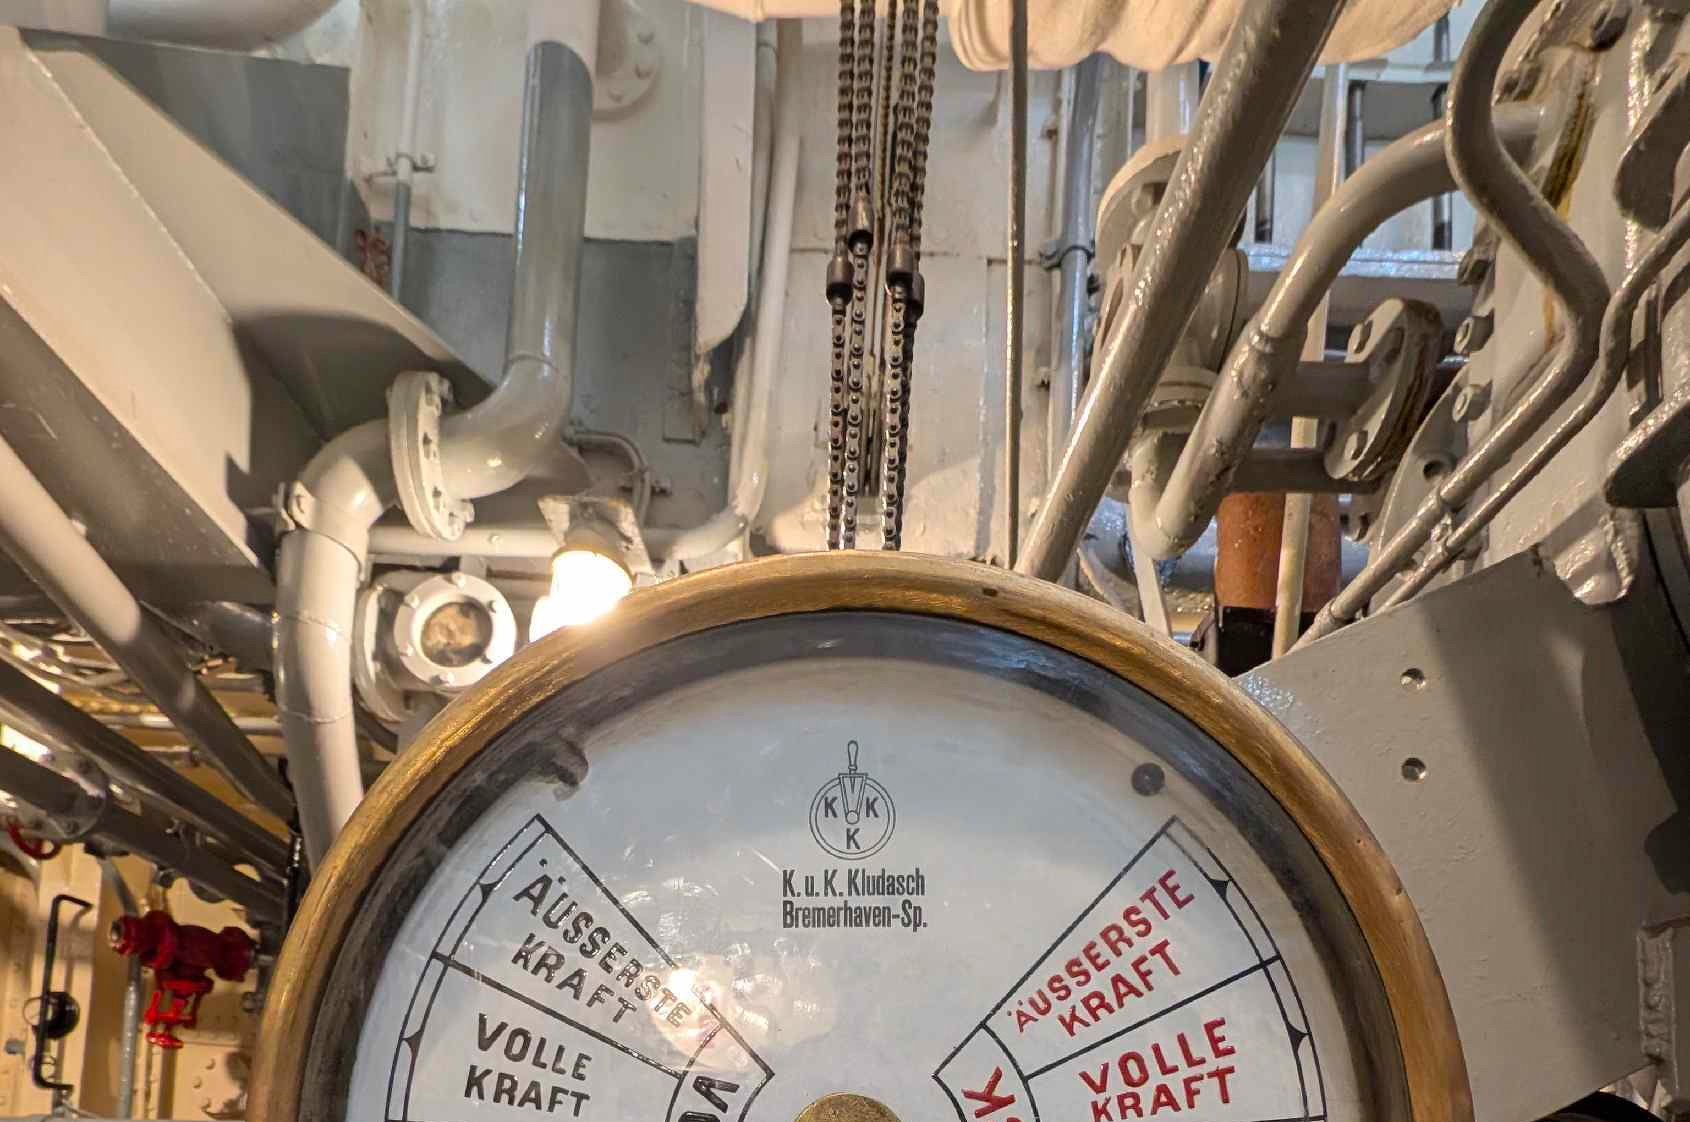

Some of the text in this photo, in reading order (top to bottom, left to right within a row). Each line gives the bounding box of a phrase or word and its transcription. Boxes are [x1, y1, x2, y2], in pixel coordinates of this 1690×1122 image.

[824, 796, 879, 818] K K
[846, 828, 860, 850] K
[782, 868, 926, 897] K. u. K. Kludasch
[782, 900, 928, 932] Bremerhaven-Sp.
[511, 932, 637, 1023] KRAFT
[512, 858, 691, 1029] ÄUSSERSTE
[1006, 869, 1195, 1033] ÄUSSERSTE
[1057, 938, 1181, 1036] KRAFT
[478, 1013, 592, 1081] VOLLE
[1078, 1016, 1236, 1095] VOLLE
[464, 1064, 591, 1117] KRAFT
